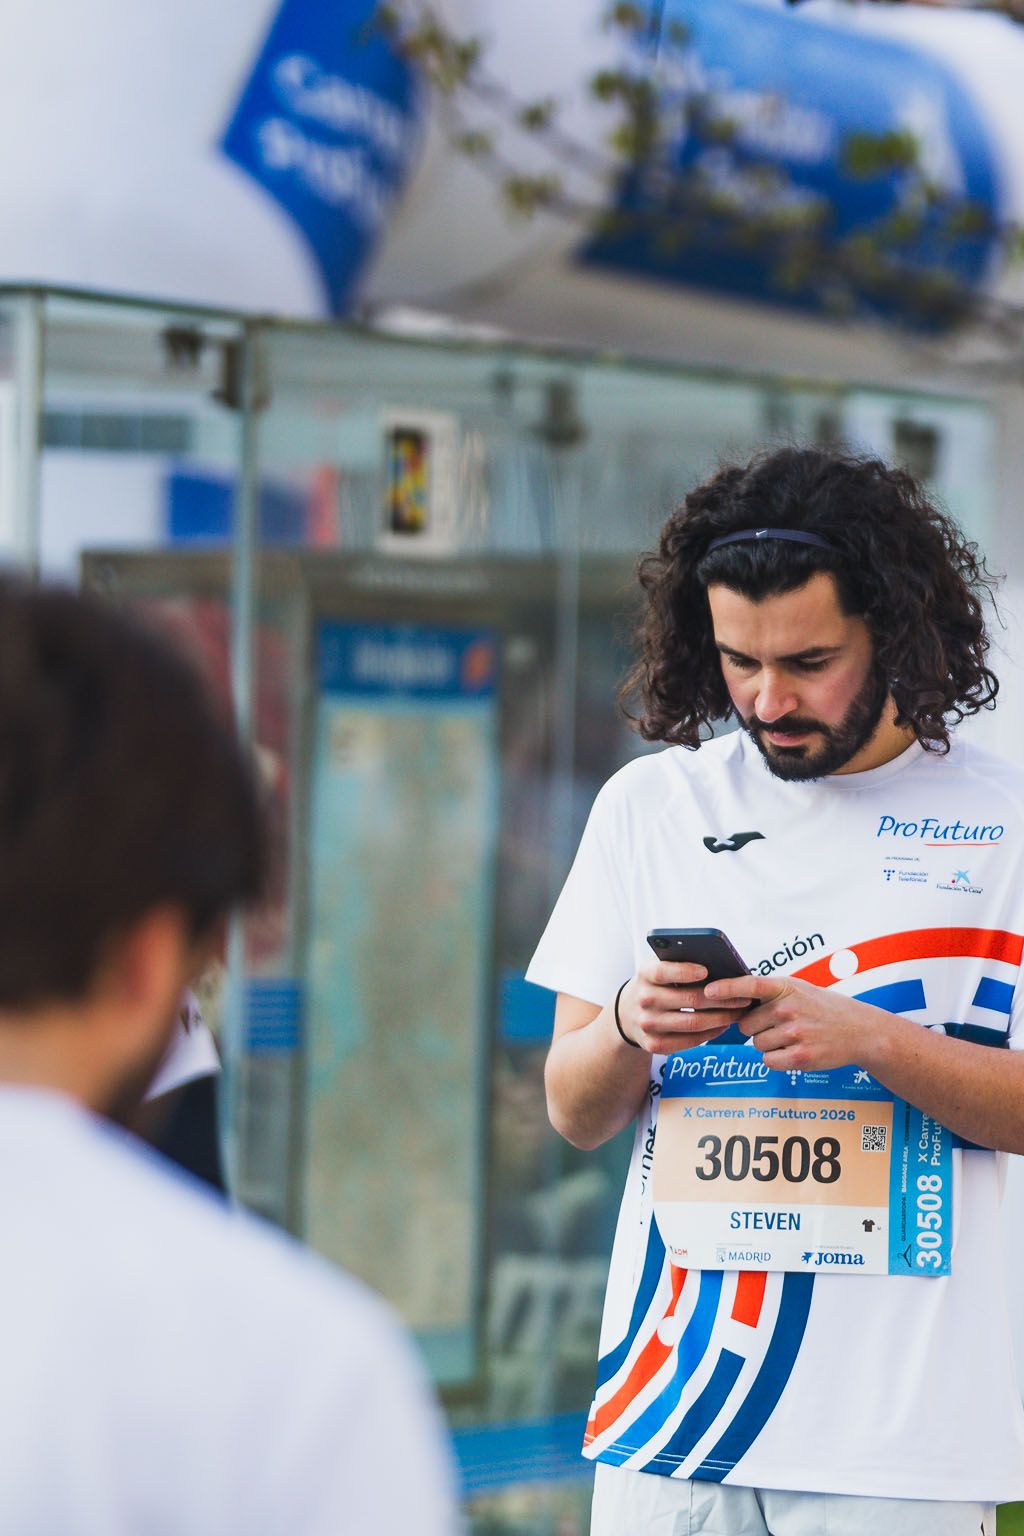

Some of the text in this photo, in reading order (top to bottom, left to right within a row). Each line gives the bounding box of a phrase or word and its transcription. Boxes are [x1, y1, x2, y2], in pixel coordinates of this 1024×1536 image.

[877, 815, 1004, 841] ProFuturo
[683, 1107, 856, 1121] X Carrera ProFuturo 2026
[695, 1134, 842, 1185] 30508
[730, 1211, 801, 1231] STEVEN
[916, 1174, 943, 1269] 30508
[728, 1251, 772, 1264] MADRID
